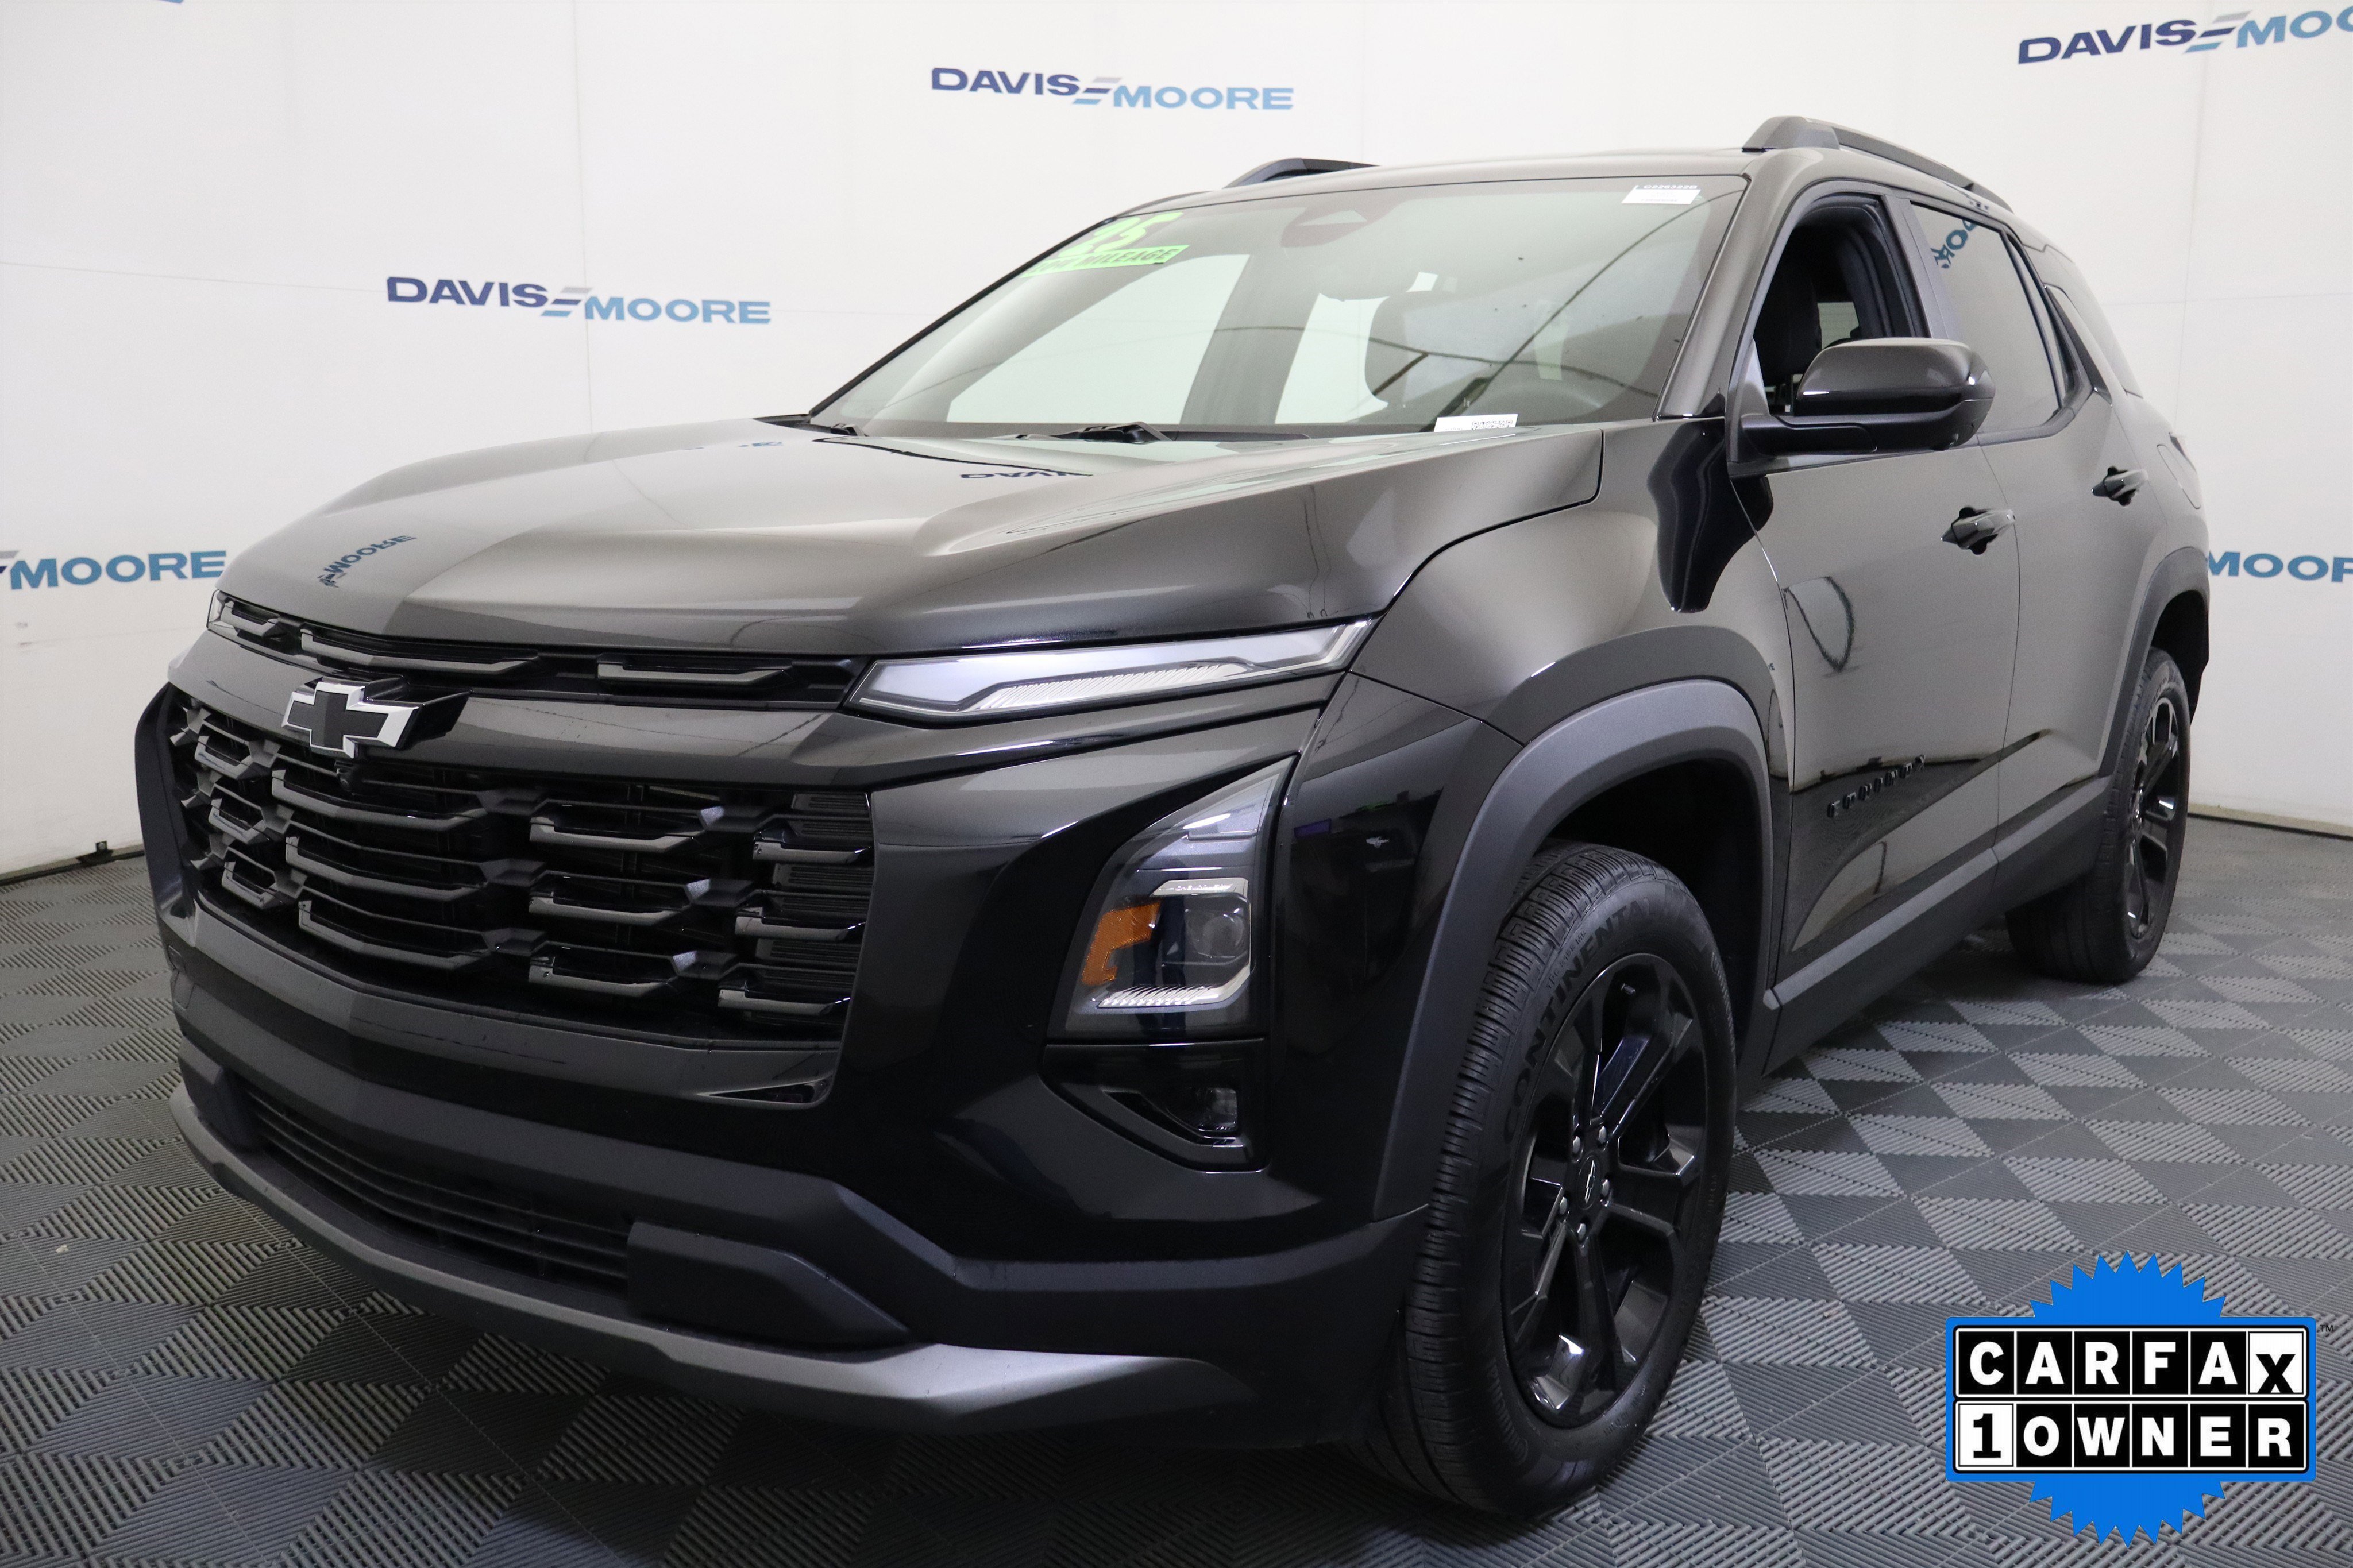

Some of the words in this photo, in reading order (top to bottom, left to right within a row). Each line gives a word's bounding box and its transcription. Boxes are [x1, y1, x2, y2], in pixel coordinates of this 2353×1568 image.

[2018, 20, 2196, 65] DAVIS
[932, 68, 1080, 97] DAVIS
[1113, 86, 1295, 111] MOORE
[1074, 249, 1179, 267] MILEAGE
[387, 277, 549, 309] DAVIS
[585, 296, 772, 325] MOORE
[10, 551, 227, 591] MOORE
[1503, 898, 1656, 1144] CONTINENTAL
